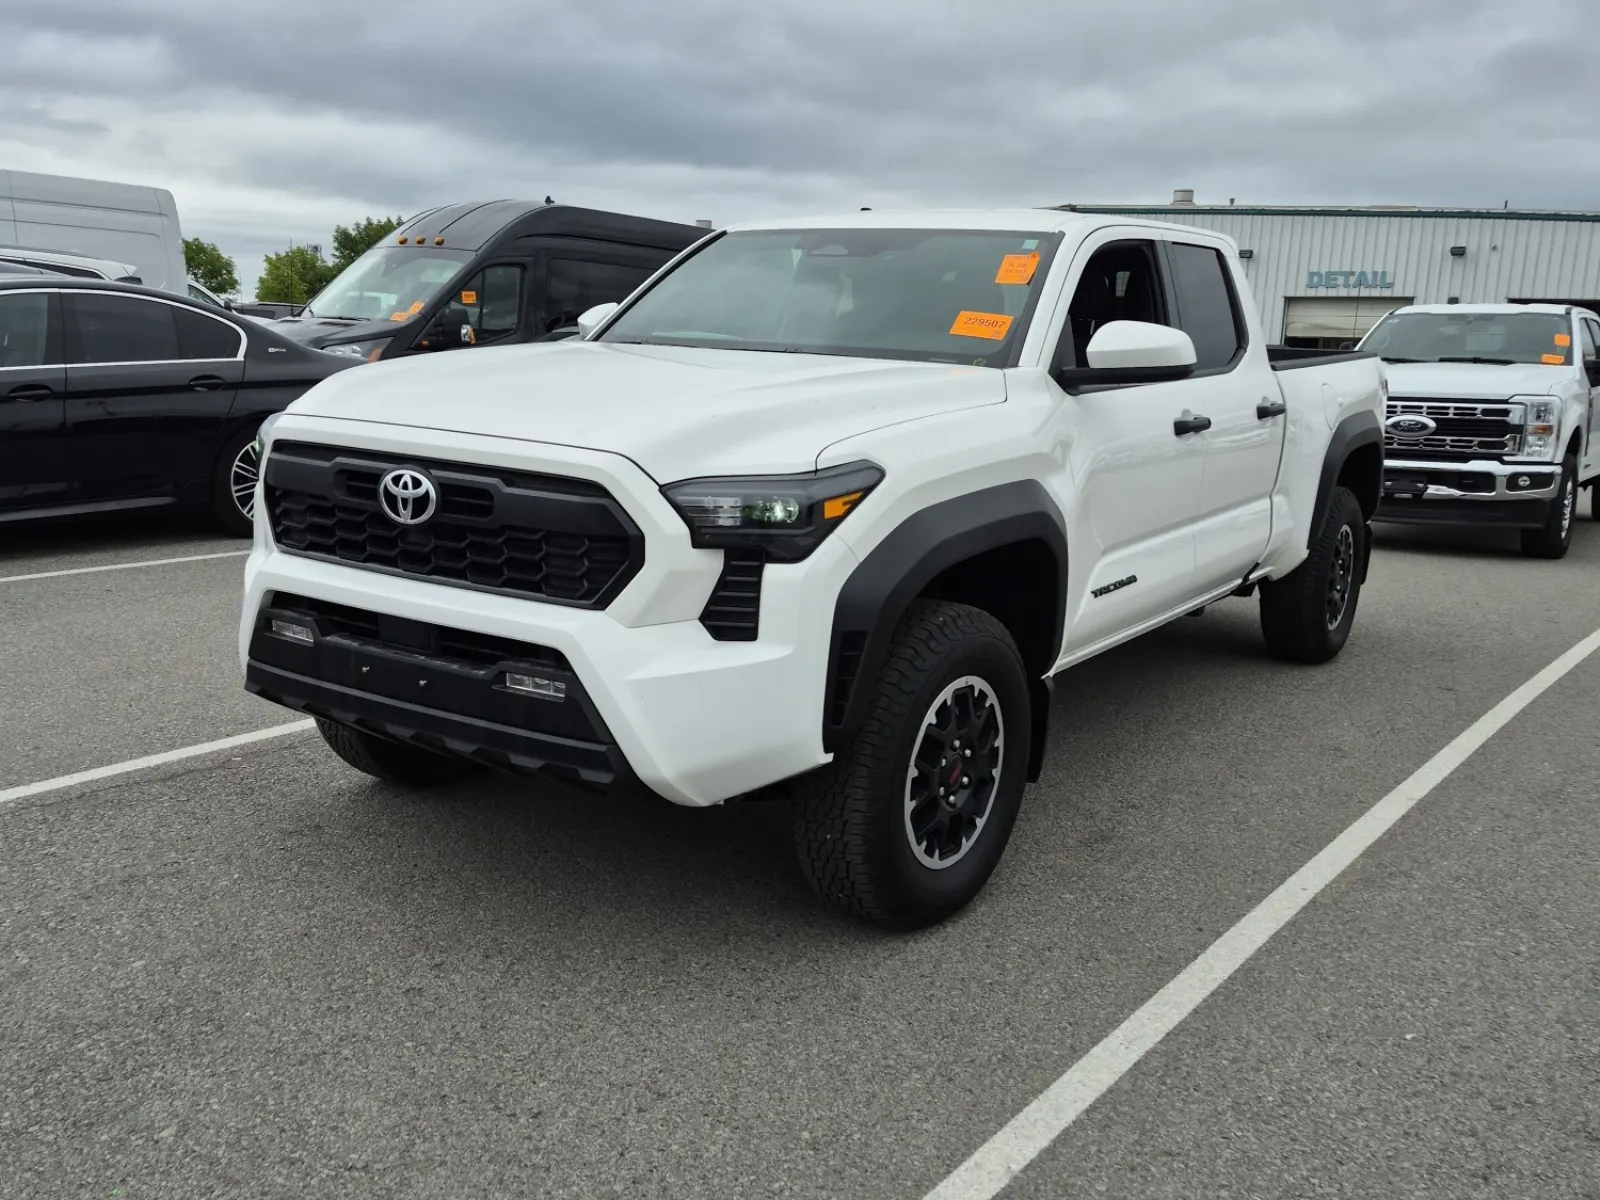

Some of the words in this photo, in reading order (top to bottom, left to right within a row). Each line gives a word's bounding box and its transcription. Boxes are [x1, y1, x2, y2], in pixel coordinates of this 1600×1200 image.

[1307, 270, 1394, 288] DETAIL
[963, 317, 1007, 329] 229507
[1090, 574, 1138, 599] TACOMA
